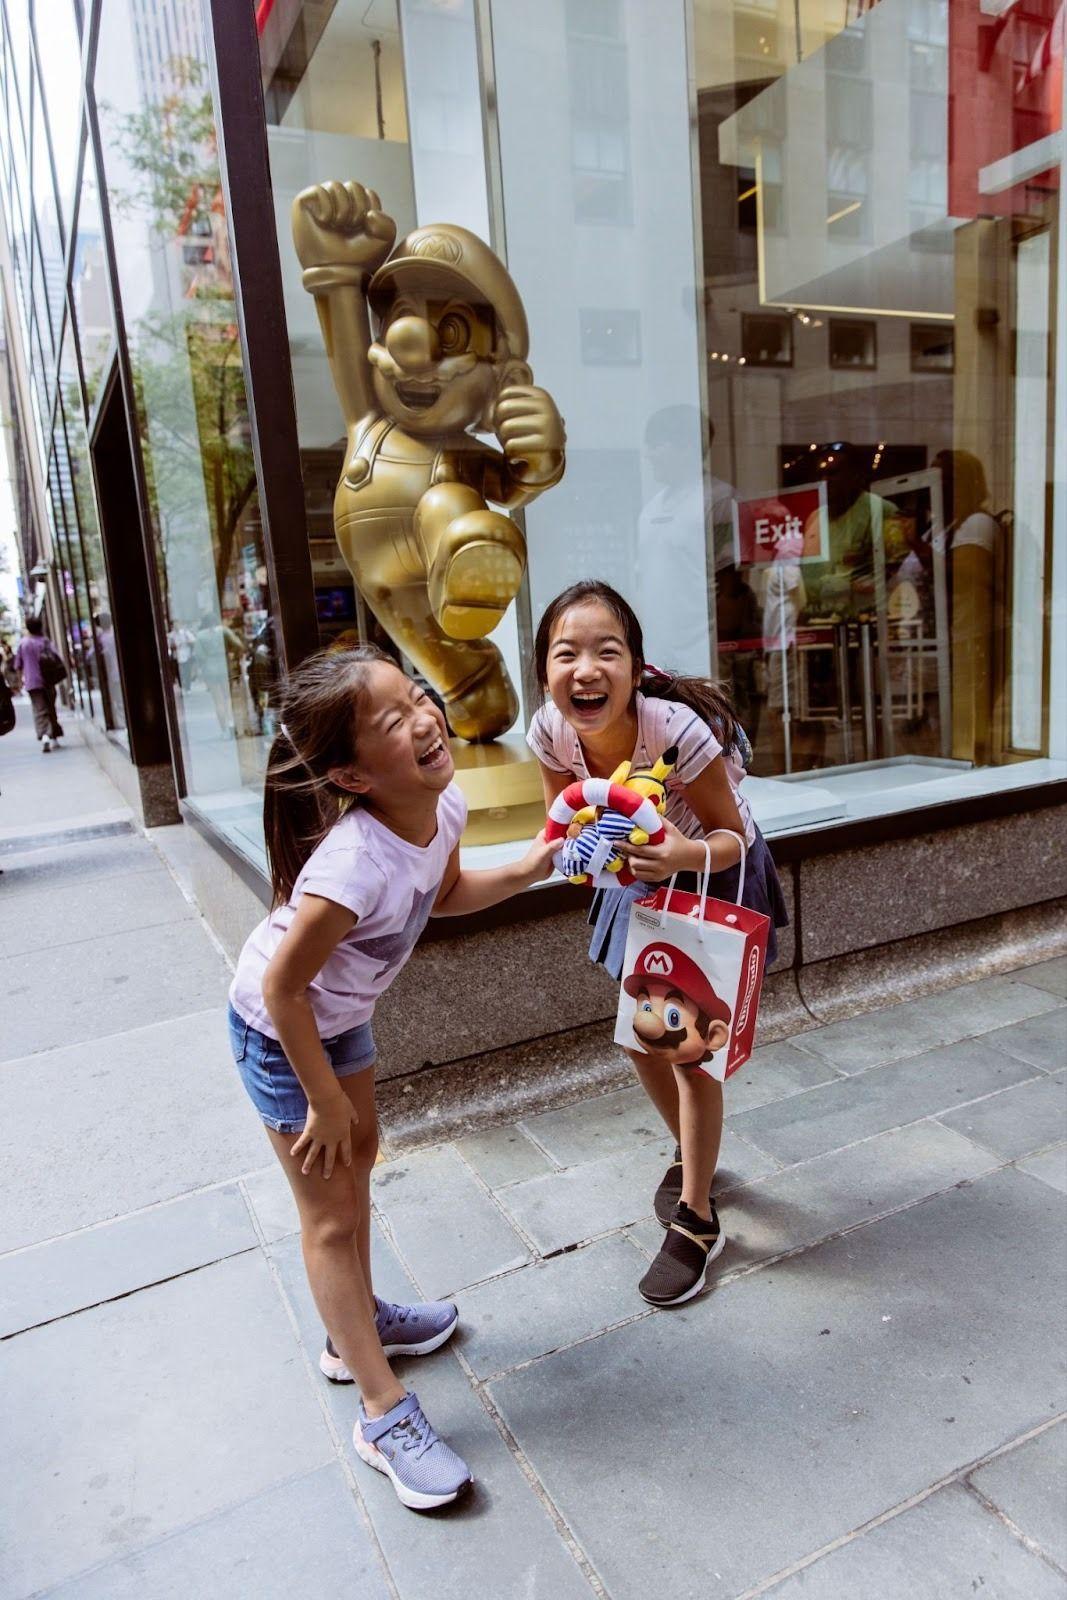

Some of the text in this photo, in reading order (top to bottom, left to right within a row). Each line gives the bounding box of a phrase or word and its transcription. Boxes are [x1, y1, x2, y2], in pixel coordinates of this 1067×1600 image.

[415, 237, 456, 260] M
[755, 514, 802, 544] Exit
[646, 953, 669, 972] M
